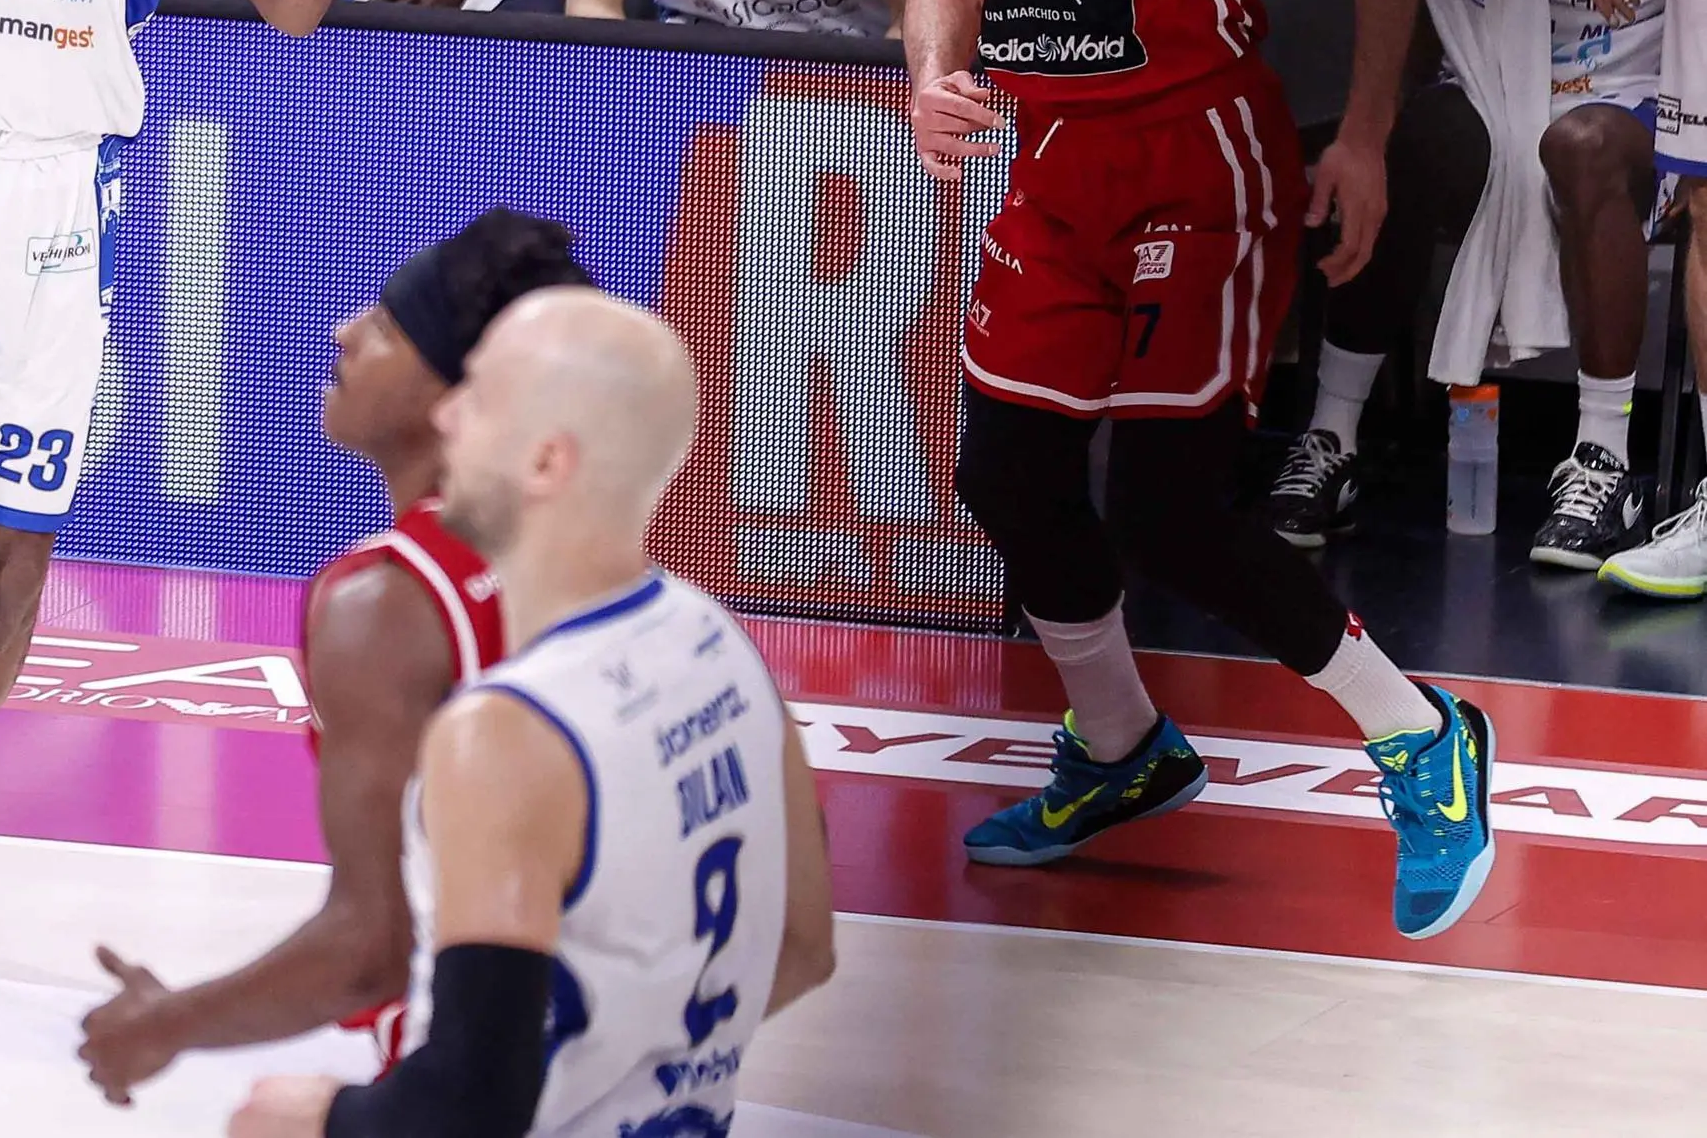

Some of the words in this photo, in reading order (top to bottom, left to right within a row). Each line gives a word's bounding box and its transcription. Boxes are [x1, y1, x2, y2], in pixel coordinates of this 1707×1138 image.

[985, 9, 1003, 22] UN
[1006, 6, 1060, 22] MARCHIO
[1063, 11, 1077, 22] DI
[1056, 33, 1126, 63] World
[1136, 244, 1169, 262] A7
[969, 298, 992, 328] A7
[15, 634, 310, 708] EA
[6, 684, 161, 710] ORIO
[684, 835, 745, 1052] 2
